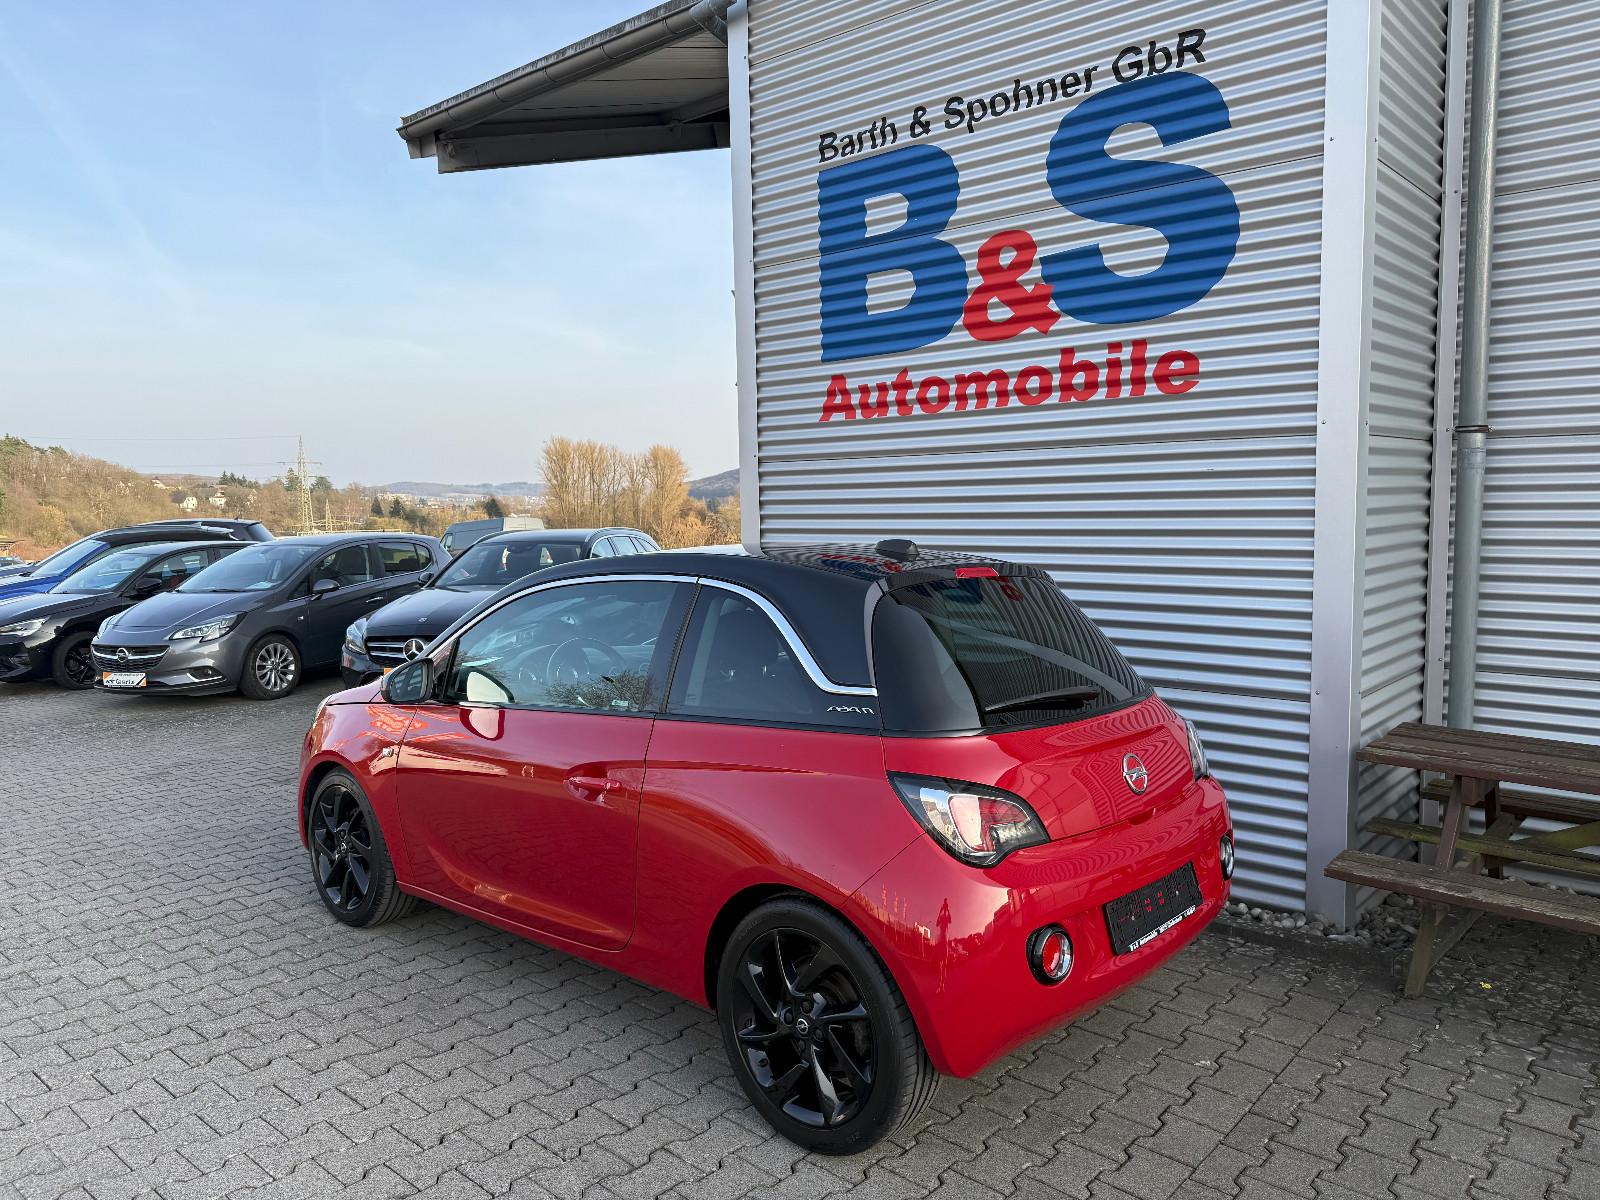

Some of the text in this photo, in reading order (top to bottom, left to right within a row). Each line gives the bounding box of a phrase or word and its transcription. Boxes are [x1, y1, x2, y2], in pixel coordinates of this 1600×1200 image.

[818, 28, 1207, 163] Barth & Spohner GbR
[818, 339, 1201, 423] Automobile
